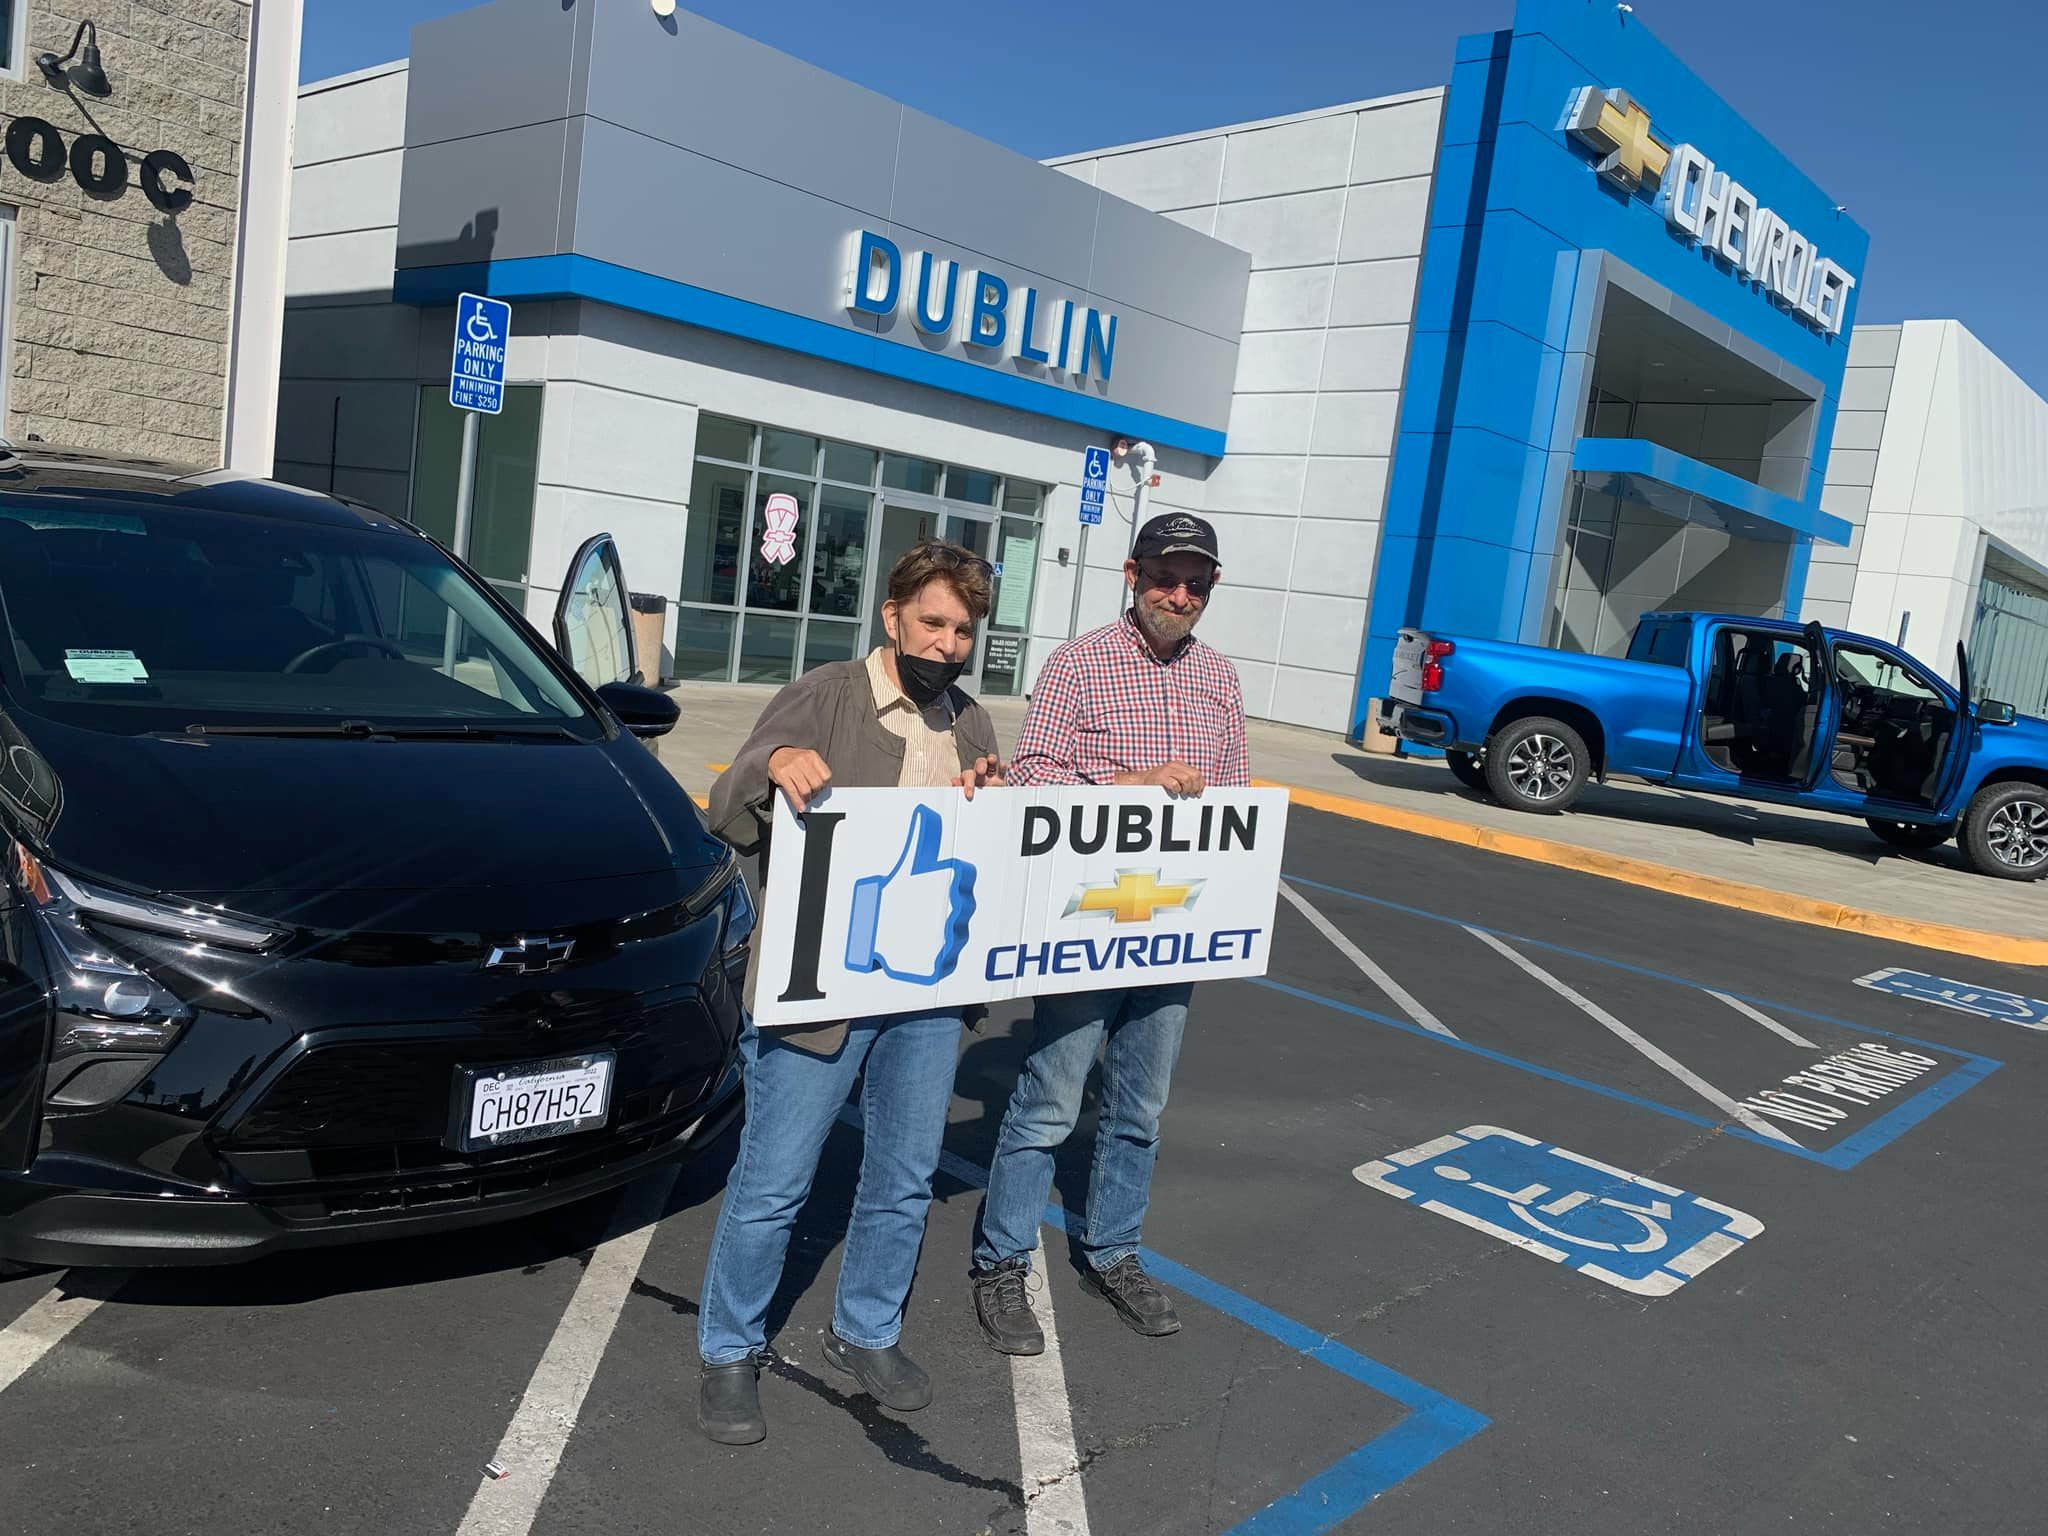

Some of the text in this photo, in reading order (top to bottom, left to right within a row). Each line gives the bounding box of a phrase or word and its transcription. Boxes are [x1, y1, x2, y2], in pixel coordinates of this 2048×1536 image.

[1665, 143, 1857, 336] CHEVROLET
[847, 229, 1118, 382] DUBLIN
[457, 338, 504, 363] PARKING
[463, 358, 495, 378] ONLY
[455, 391, 498, 409] FINE $250
[459, 378, 496, 395] MINIMUM
[1085, 489, 1101, 502] ONLY
[1021, 804, 1260, 857] DUBLIN
[777, 812, 847, 1003] I
[985, 928, 1263, 982] CHEVROLET
[479, 1082, 596, 1132] CH87H52
[483, 1081, 500, 1093] DEC
[1737, 1042, 1938, 1131] NO PARKING
